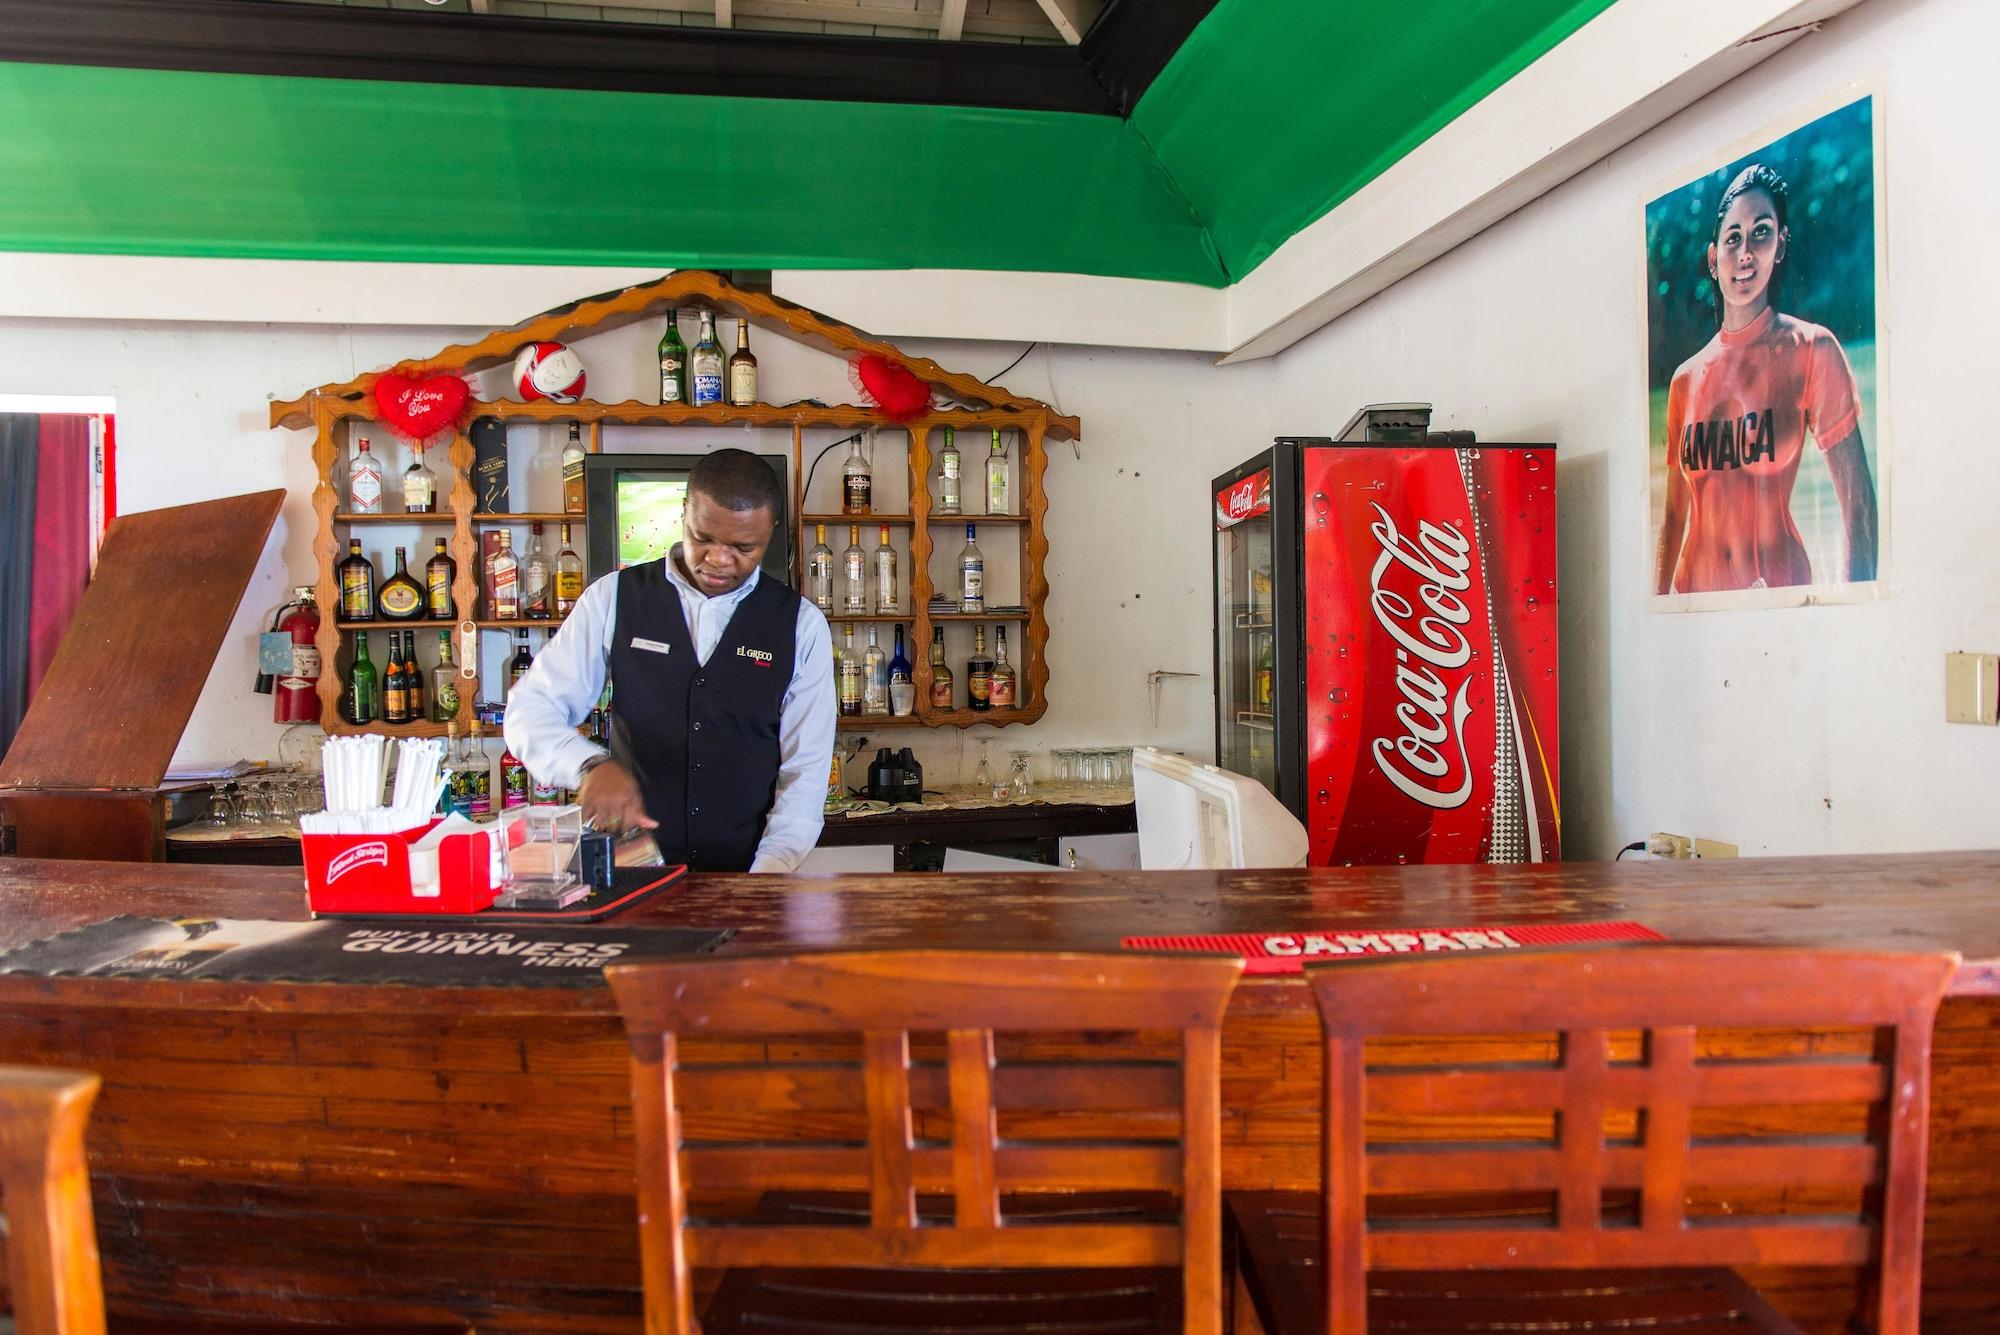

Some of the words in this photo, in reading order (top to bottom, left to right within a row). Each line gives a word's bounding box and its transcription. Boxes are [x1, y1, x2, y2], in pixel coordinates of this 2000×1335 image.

[398, 389, 412, 404] I
[412, 388, 444, 403] Love
[408, 401, 431, 417] You
[1680, 408, 1775, 471] AMAICA
[746, 649, 772, 661] GRECO
[1371, 500, 1473, 809] Coca-Cola
[342, 938, 630, 958] GUINNESS
[1263, 929, 1520, 957] CAMPARI
[522, 956, 609, 968] HERE
